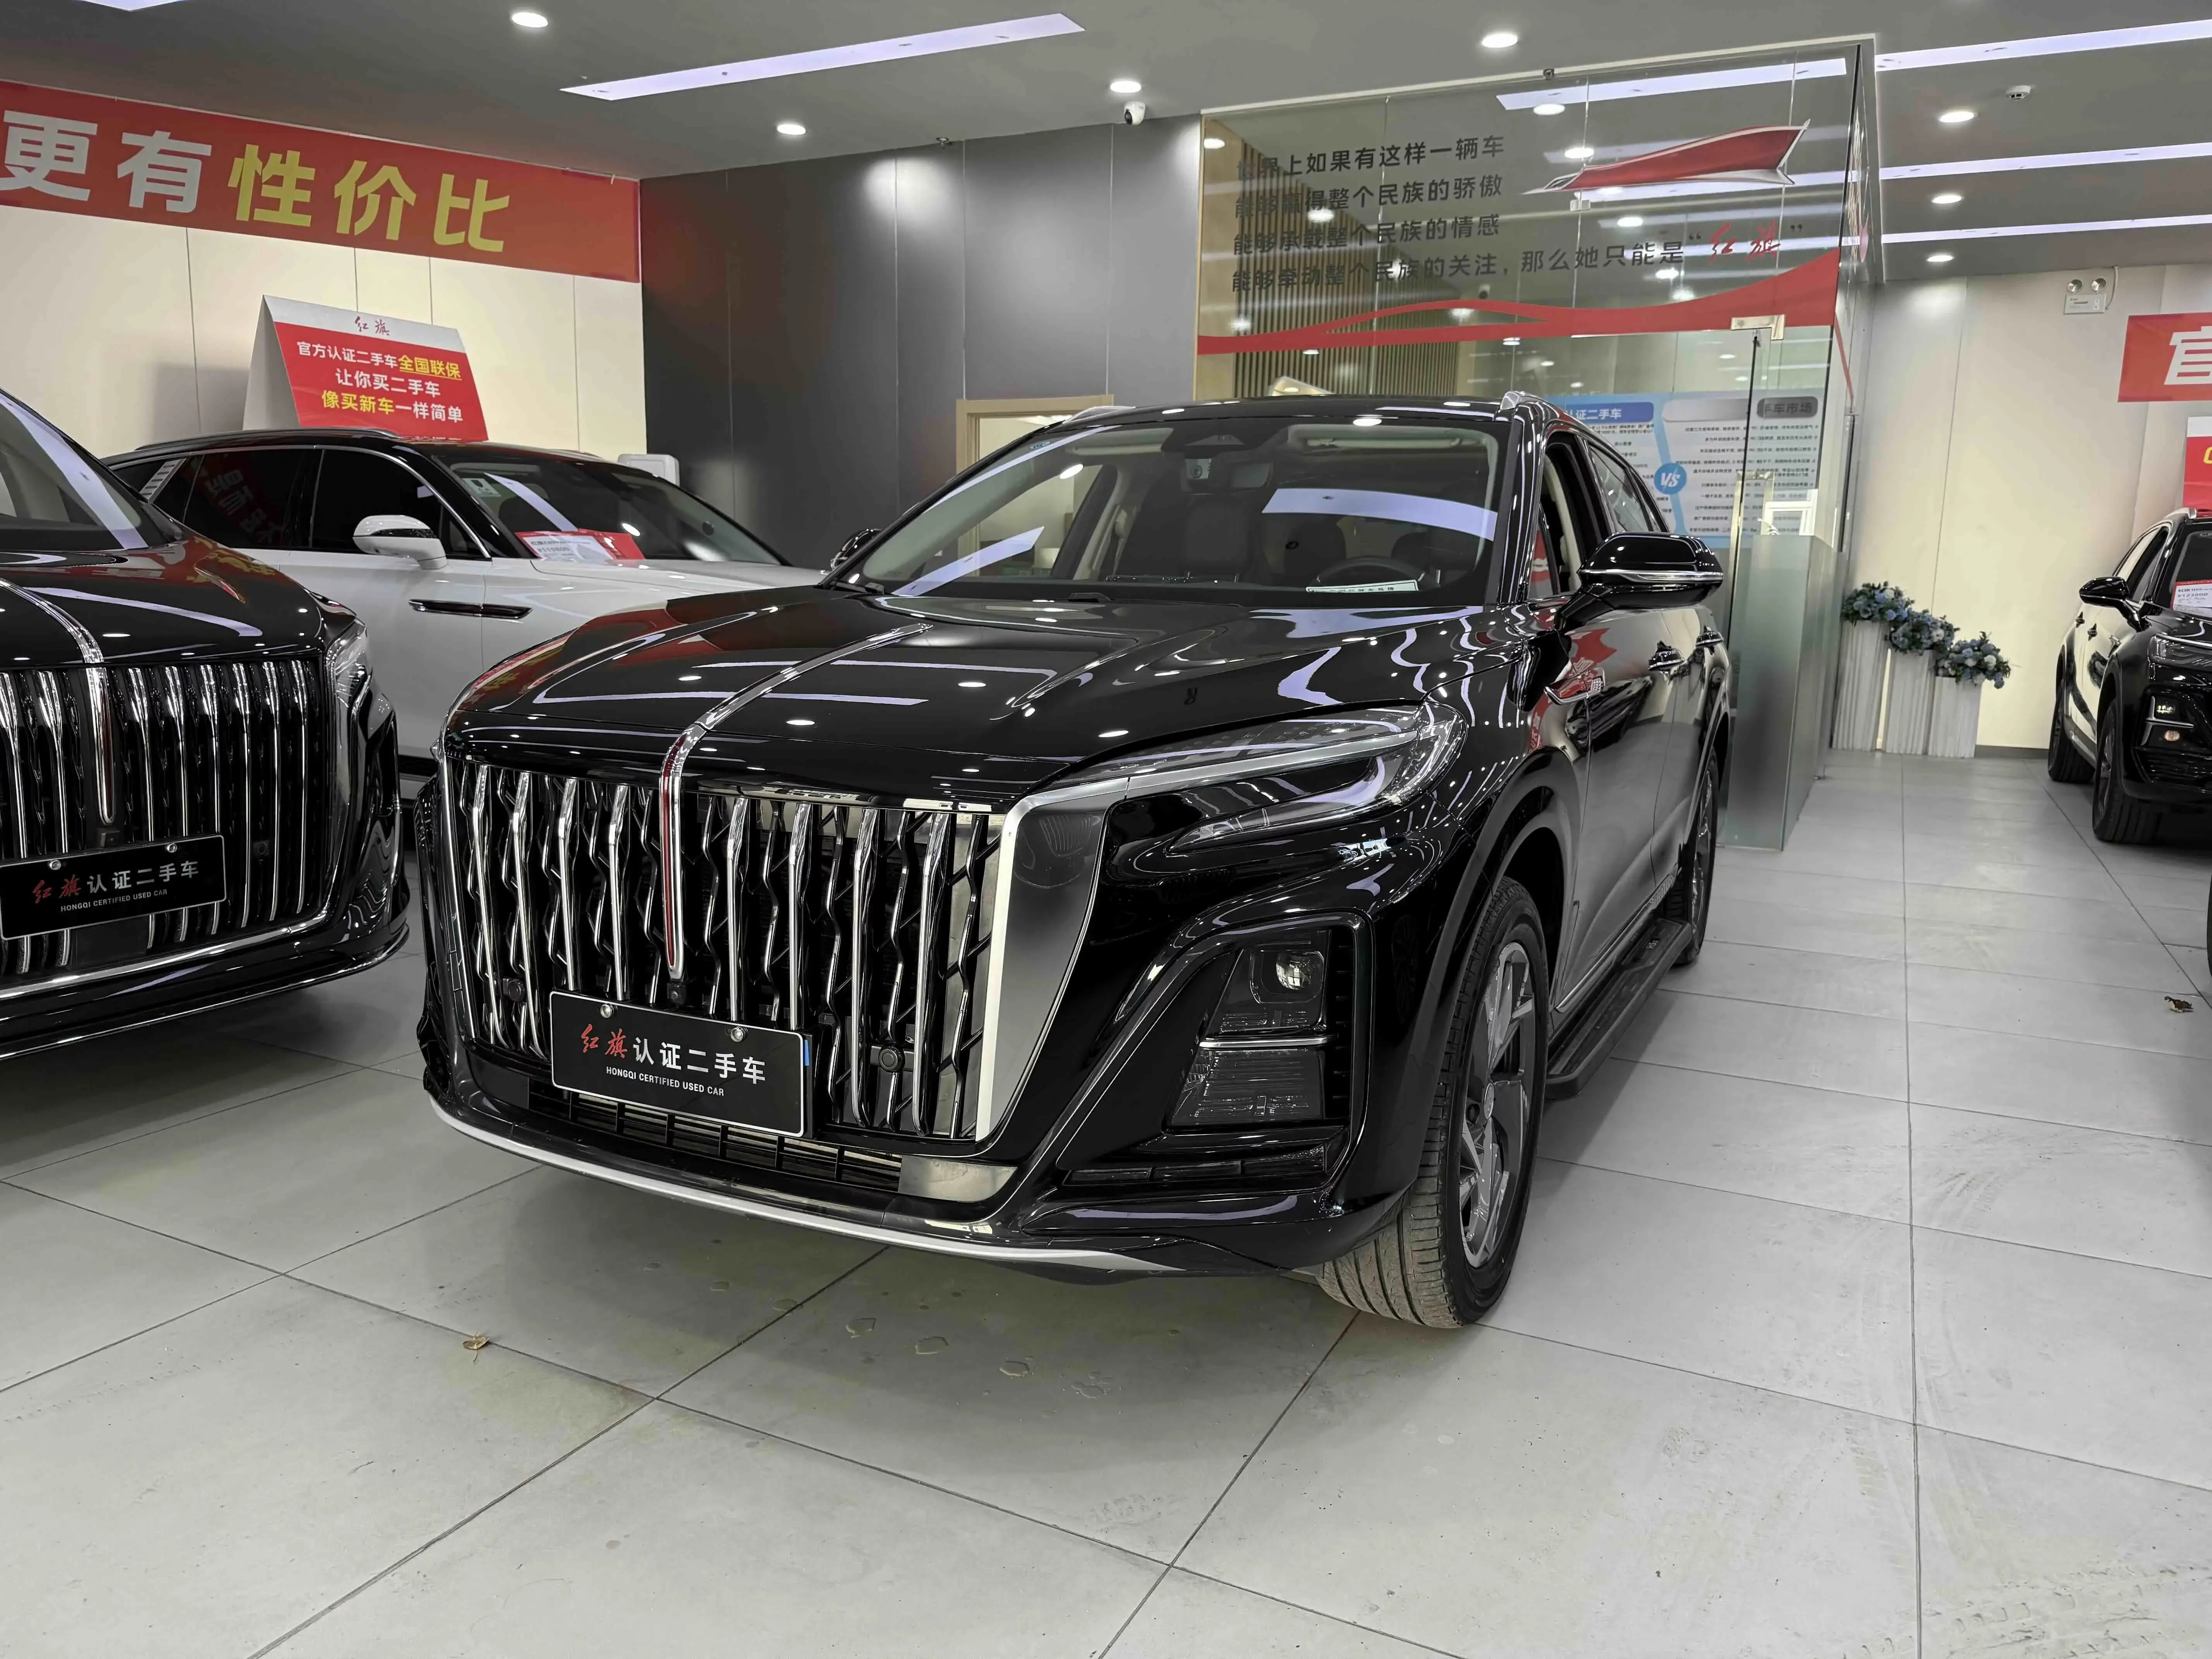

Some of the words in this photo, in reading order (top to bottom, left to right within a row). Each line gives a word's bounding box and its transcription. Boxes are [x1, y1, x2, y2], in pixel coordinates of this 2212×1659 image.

[1, 110, 510, 252] 更有性价比
[355, 316, 390, 336] 红旗
[335, 368, 441, 397] 让你买二手车
[321, 390, 463, 423] 像买新车一样简单
[1570, 409, 1622, 420] 证二手车
[1661, 473, 1681, 487] VS
[60, 902, 91, 912] HONGQI
[93, 895, 131, 907] CERTIFIED
[133, 891, 152, 900] USED
[606, 1066, 637, 1080] HONGQI
[639, 1073, 680, 1088] CERTIFIED
[682, 1081, 705, 1093] USED
[707, 1086, 725, 1097] CAR
